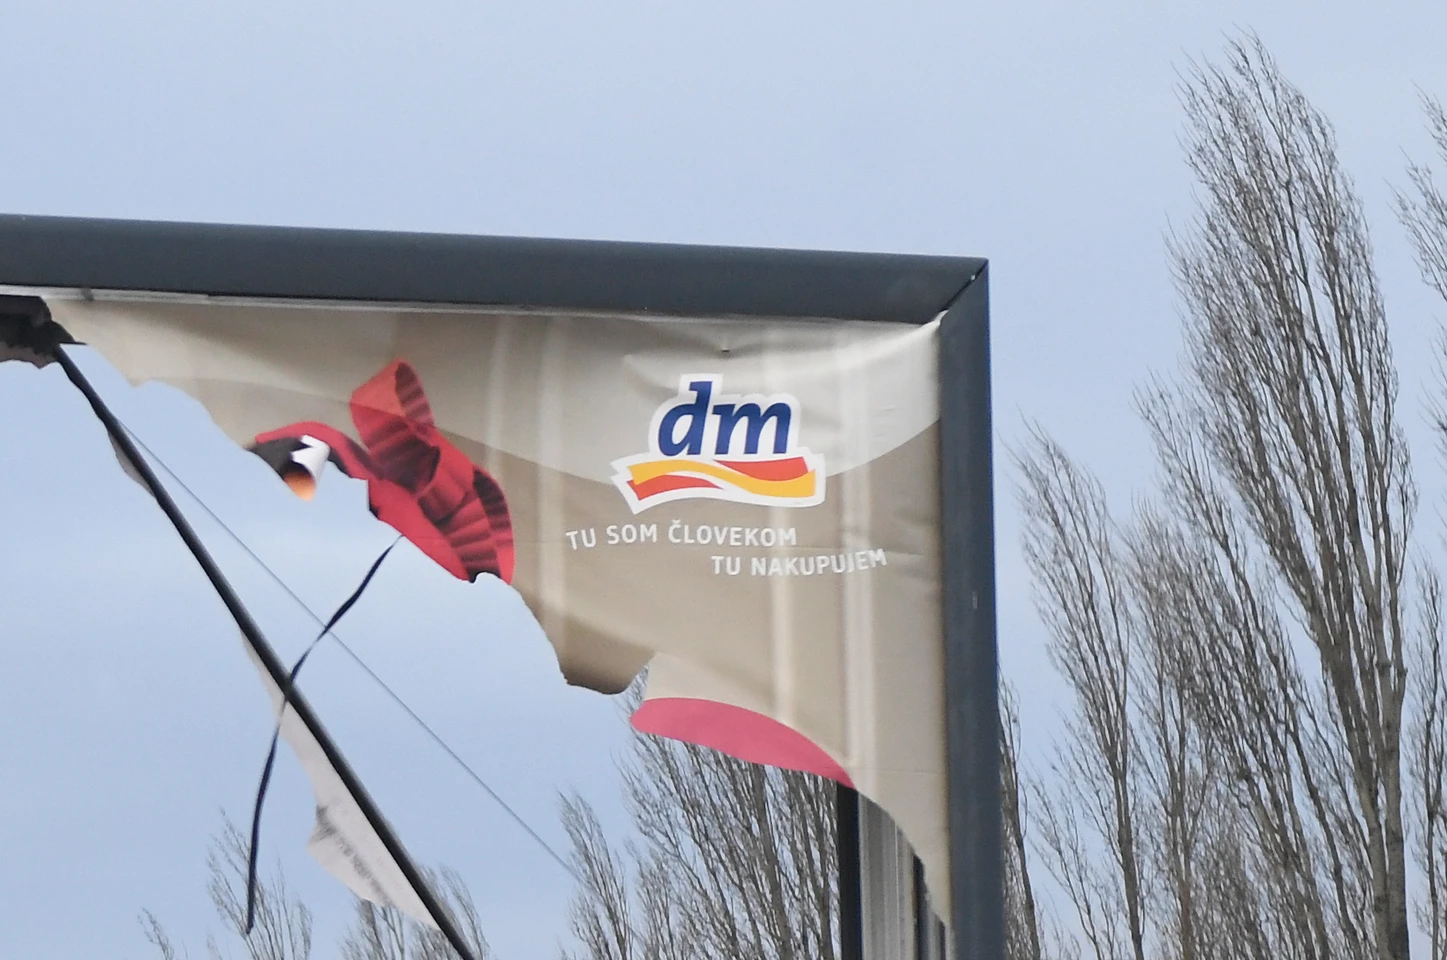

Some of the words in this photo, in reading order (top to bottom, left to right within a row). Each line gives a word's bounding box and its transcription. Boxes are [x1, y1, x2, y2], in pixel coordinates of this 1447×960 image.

[658, 380, 792, 457] dm
[565, 528, 597, 551] TU
[606, 524, 658, 546] SOM
[668, 519, 798, 547] ČLOVEKOM
[711, 555, 741, 576] TU
[750, 548, 888, 577] NAKUPUJEM
